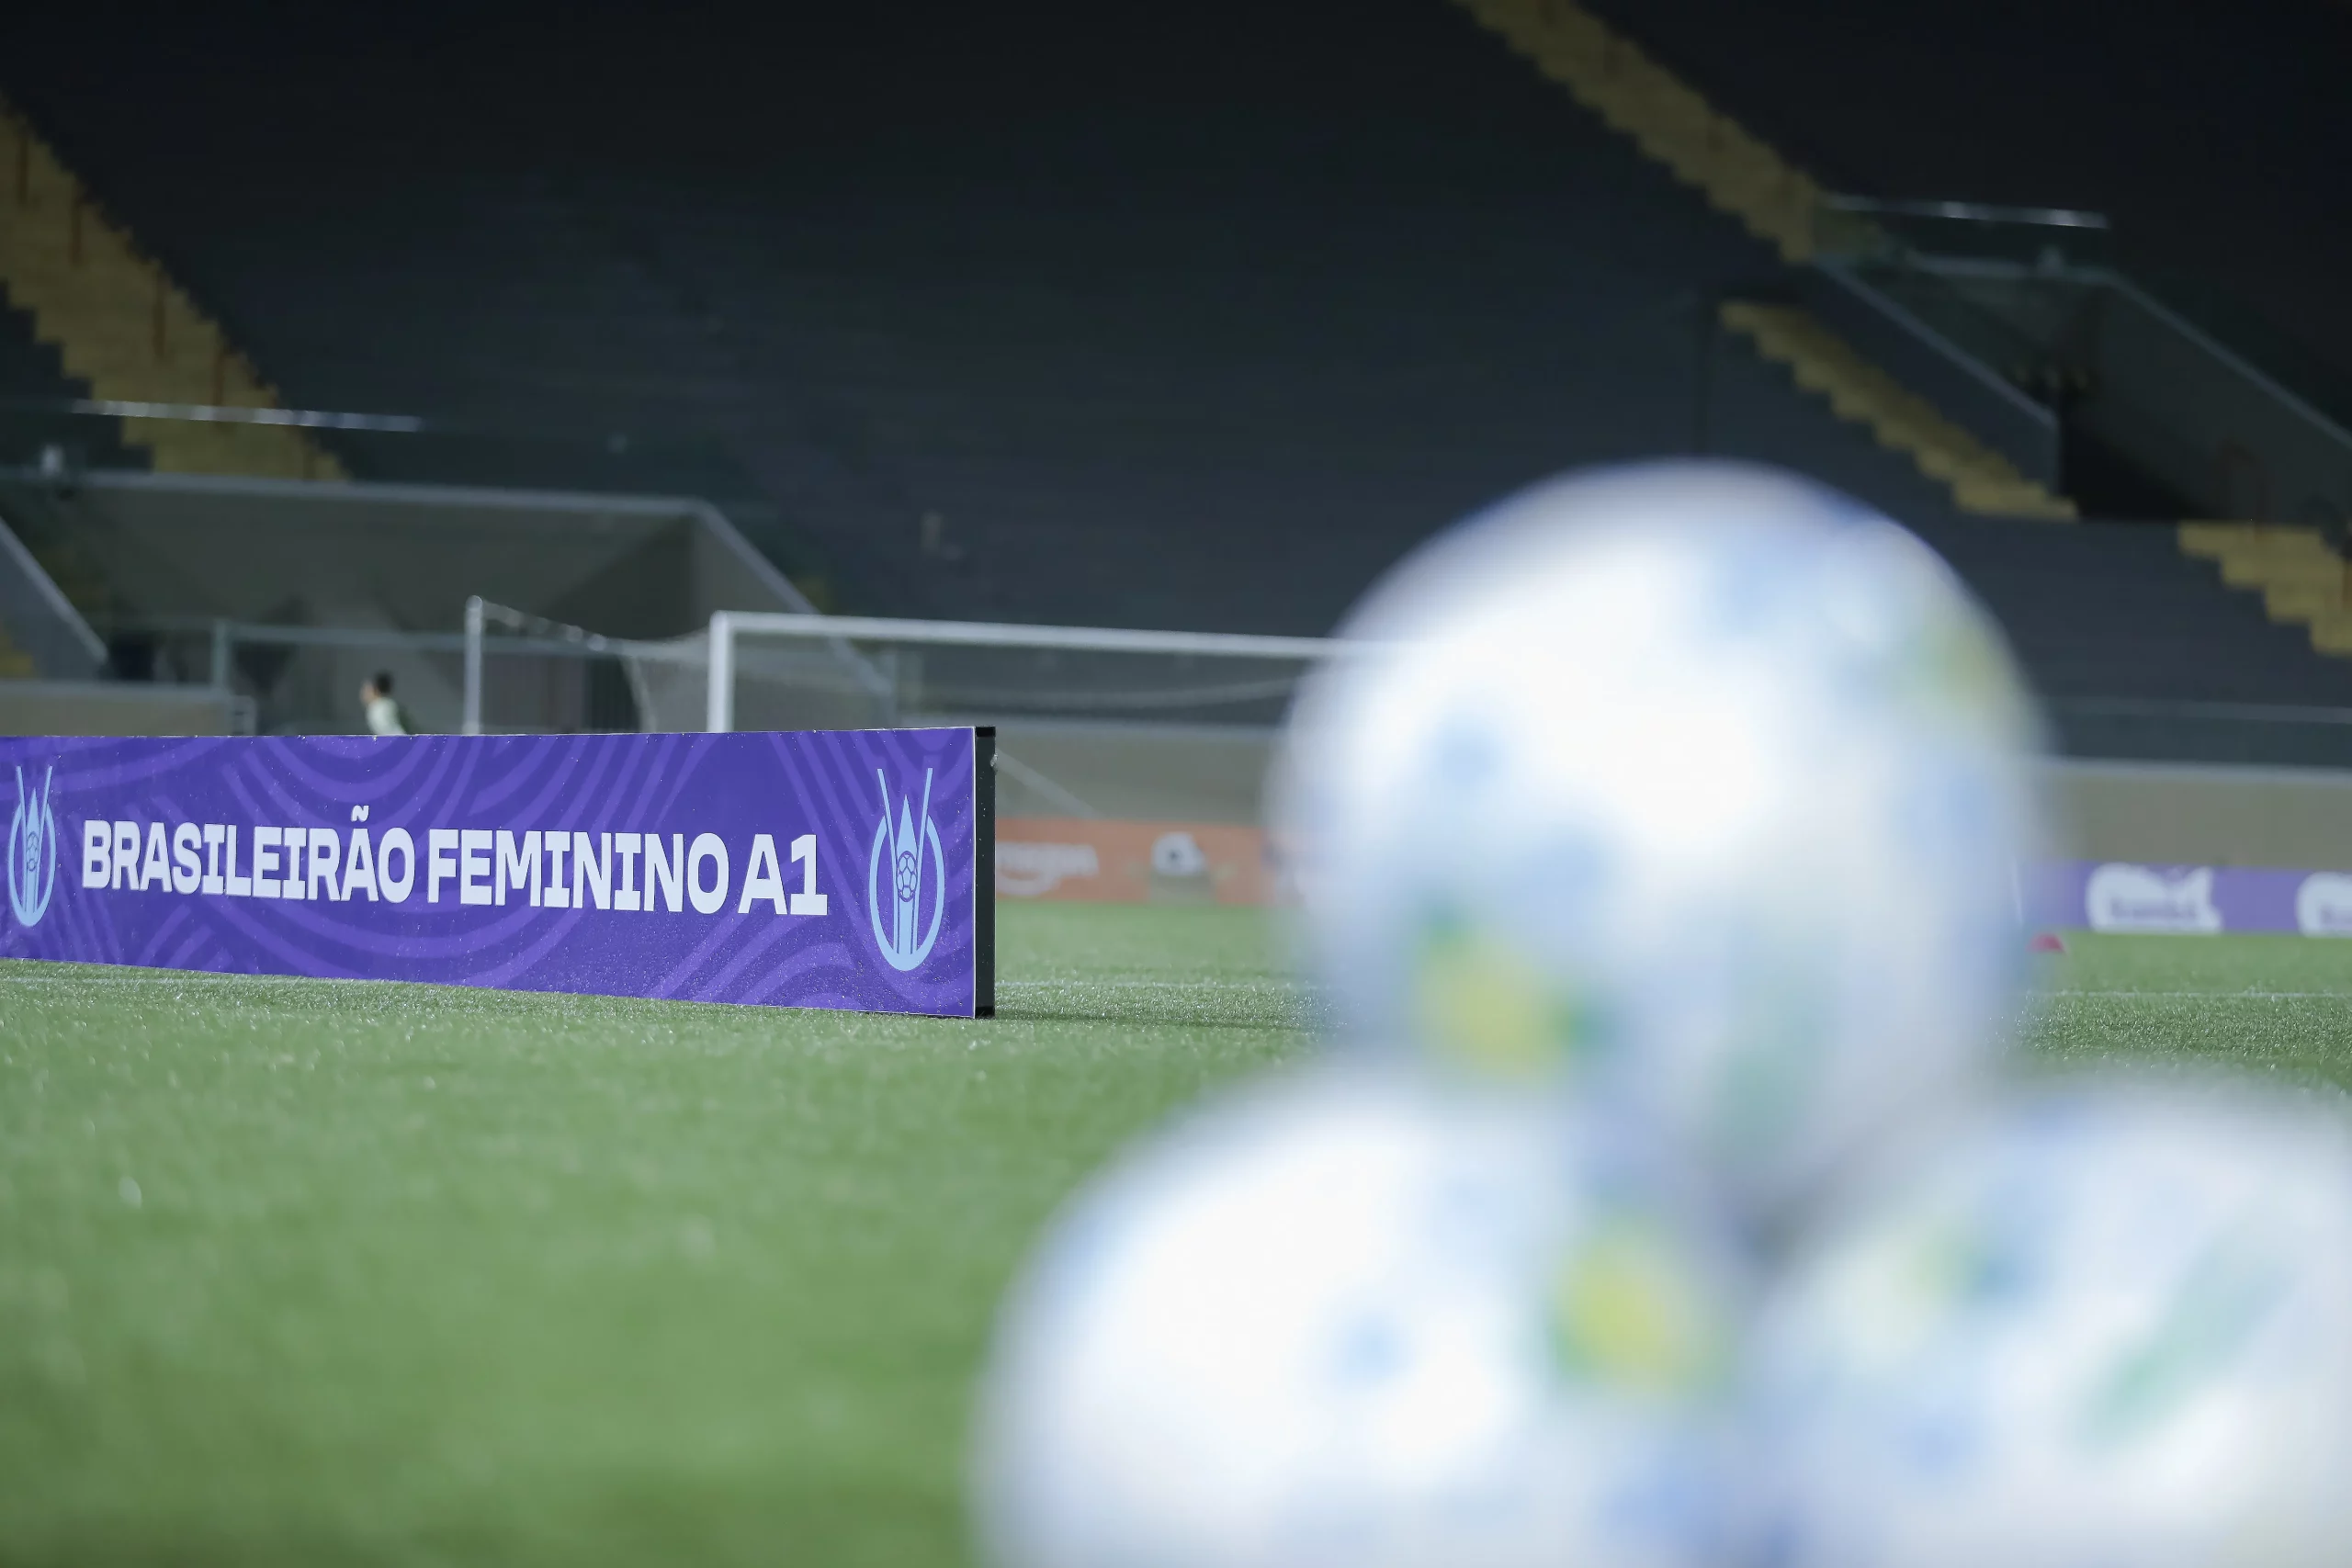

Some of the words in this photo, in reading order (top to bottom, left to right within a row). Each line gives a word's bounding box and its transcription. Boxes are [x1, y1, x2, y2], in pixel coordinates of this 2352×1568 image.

[82, 805, 415, 904] BRASILEIRÃO
[427, 828, 729, 915] FEMININO
[737, 833, 829, 917] A1
